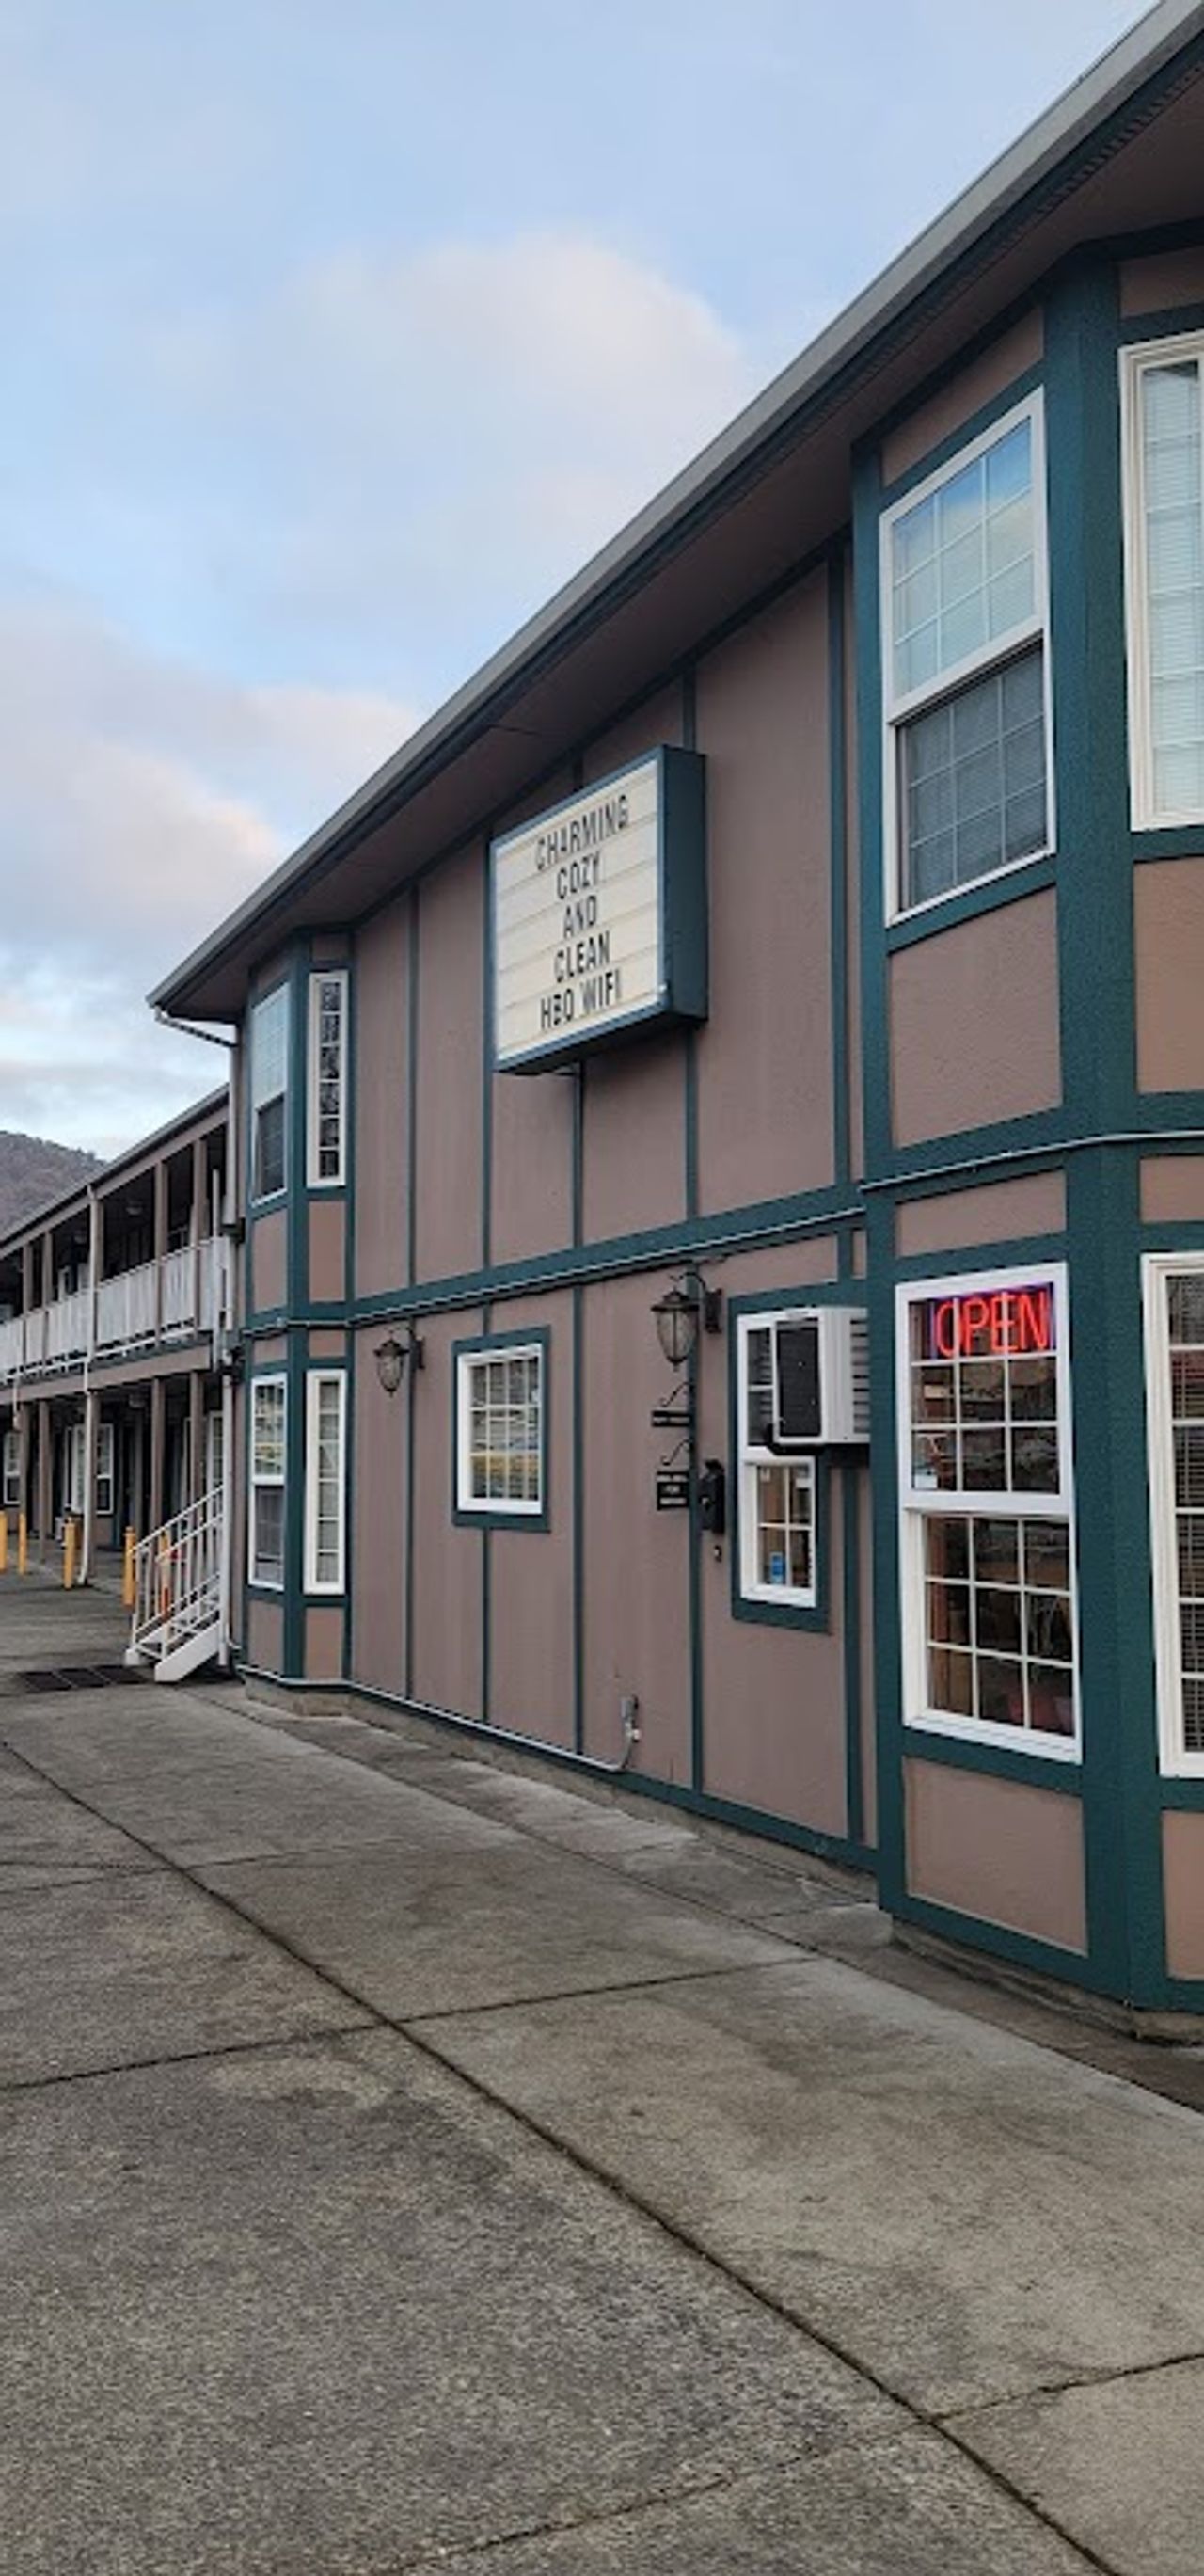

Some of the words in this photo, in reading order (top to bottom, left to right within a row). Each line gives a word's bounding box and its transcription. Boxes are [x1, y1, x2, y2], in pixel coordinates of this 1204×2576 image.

[535, 795, 629, 870] CHARMING
[557, 851, 600, 899] COZY
[563, 896, 597, 939] AND
[554, 930, 610, 983] CLEAN
[540, 989, 575, 1030] HBO
[579, 968, 622, 1016] WIFI
[935, 1290, 1050, 1358] OPEN
